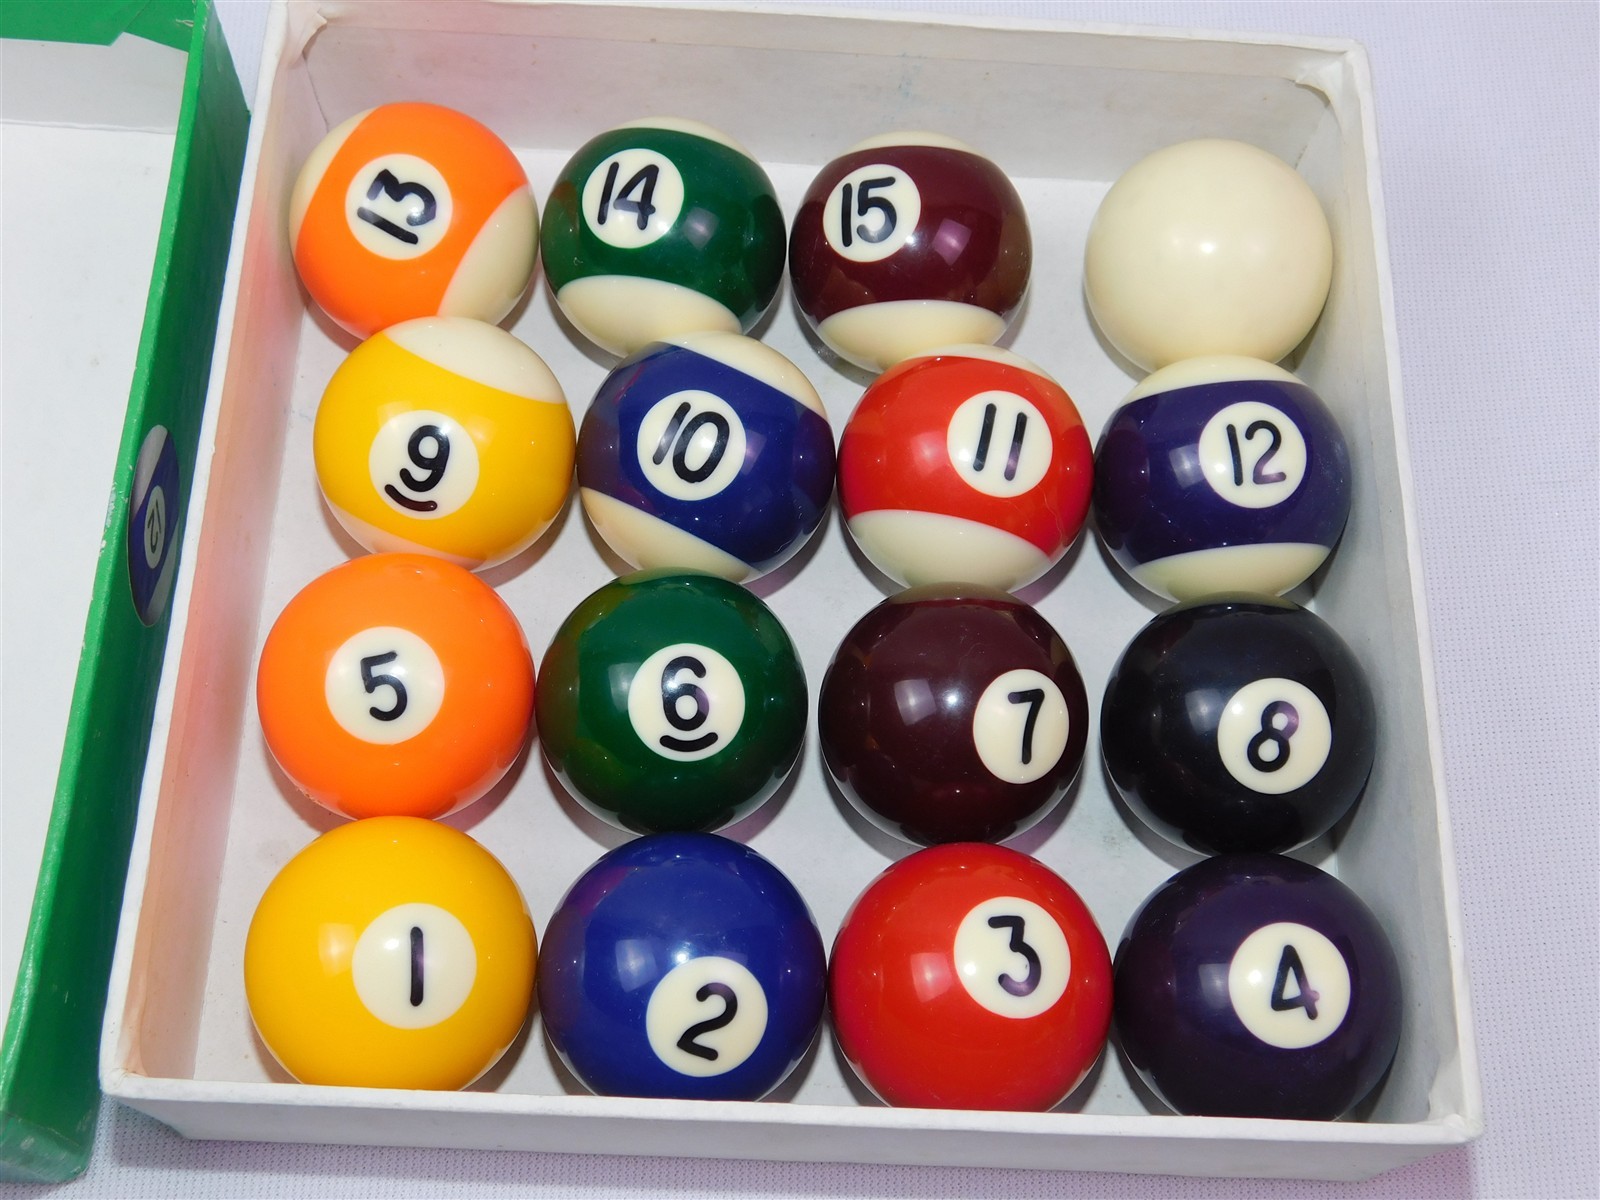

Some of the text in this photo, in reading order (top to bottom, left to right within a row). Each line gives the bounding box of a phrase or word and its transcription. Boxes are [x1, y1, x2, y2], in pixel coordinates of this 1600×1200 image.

[356, 168, 437, 246] 13
[596, 161, 660, 231] 14
[840, 176, 898, 248] 15
[397, 424, 451, 493] 9
[652, 401, 731, 484] 10
[972, 402, 1028, 482] 11
[1225, 419, 1287, 487] 12
[359, 650, 408, 722] 5
[660, 655, 710, 732] 6
[1007, 687, 1046, 766] 7
[1246, 700, 1299, 774] 8
[408, 925, 425, 1008] 1
[987, 914, 1042, 998] 3
[1270, 944, 1319, 1021] 4
[675, 982, 739, 1062] 2
